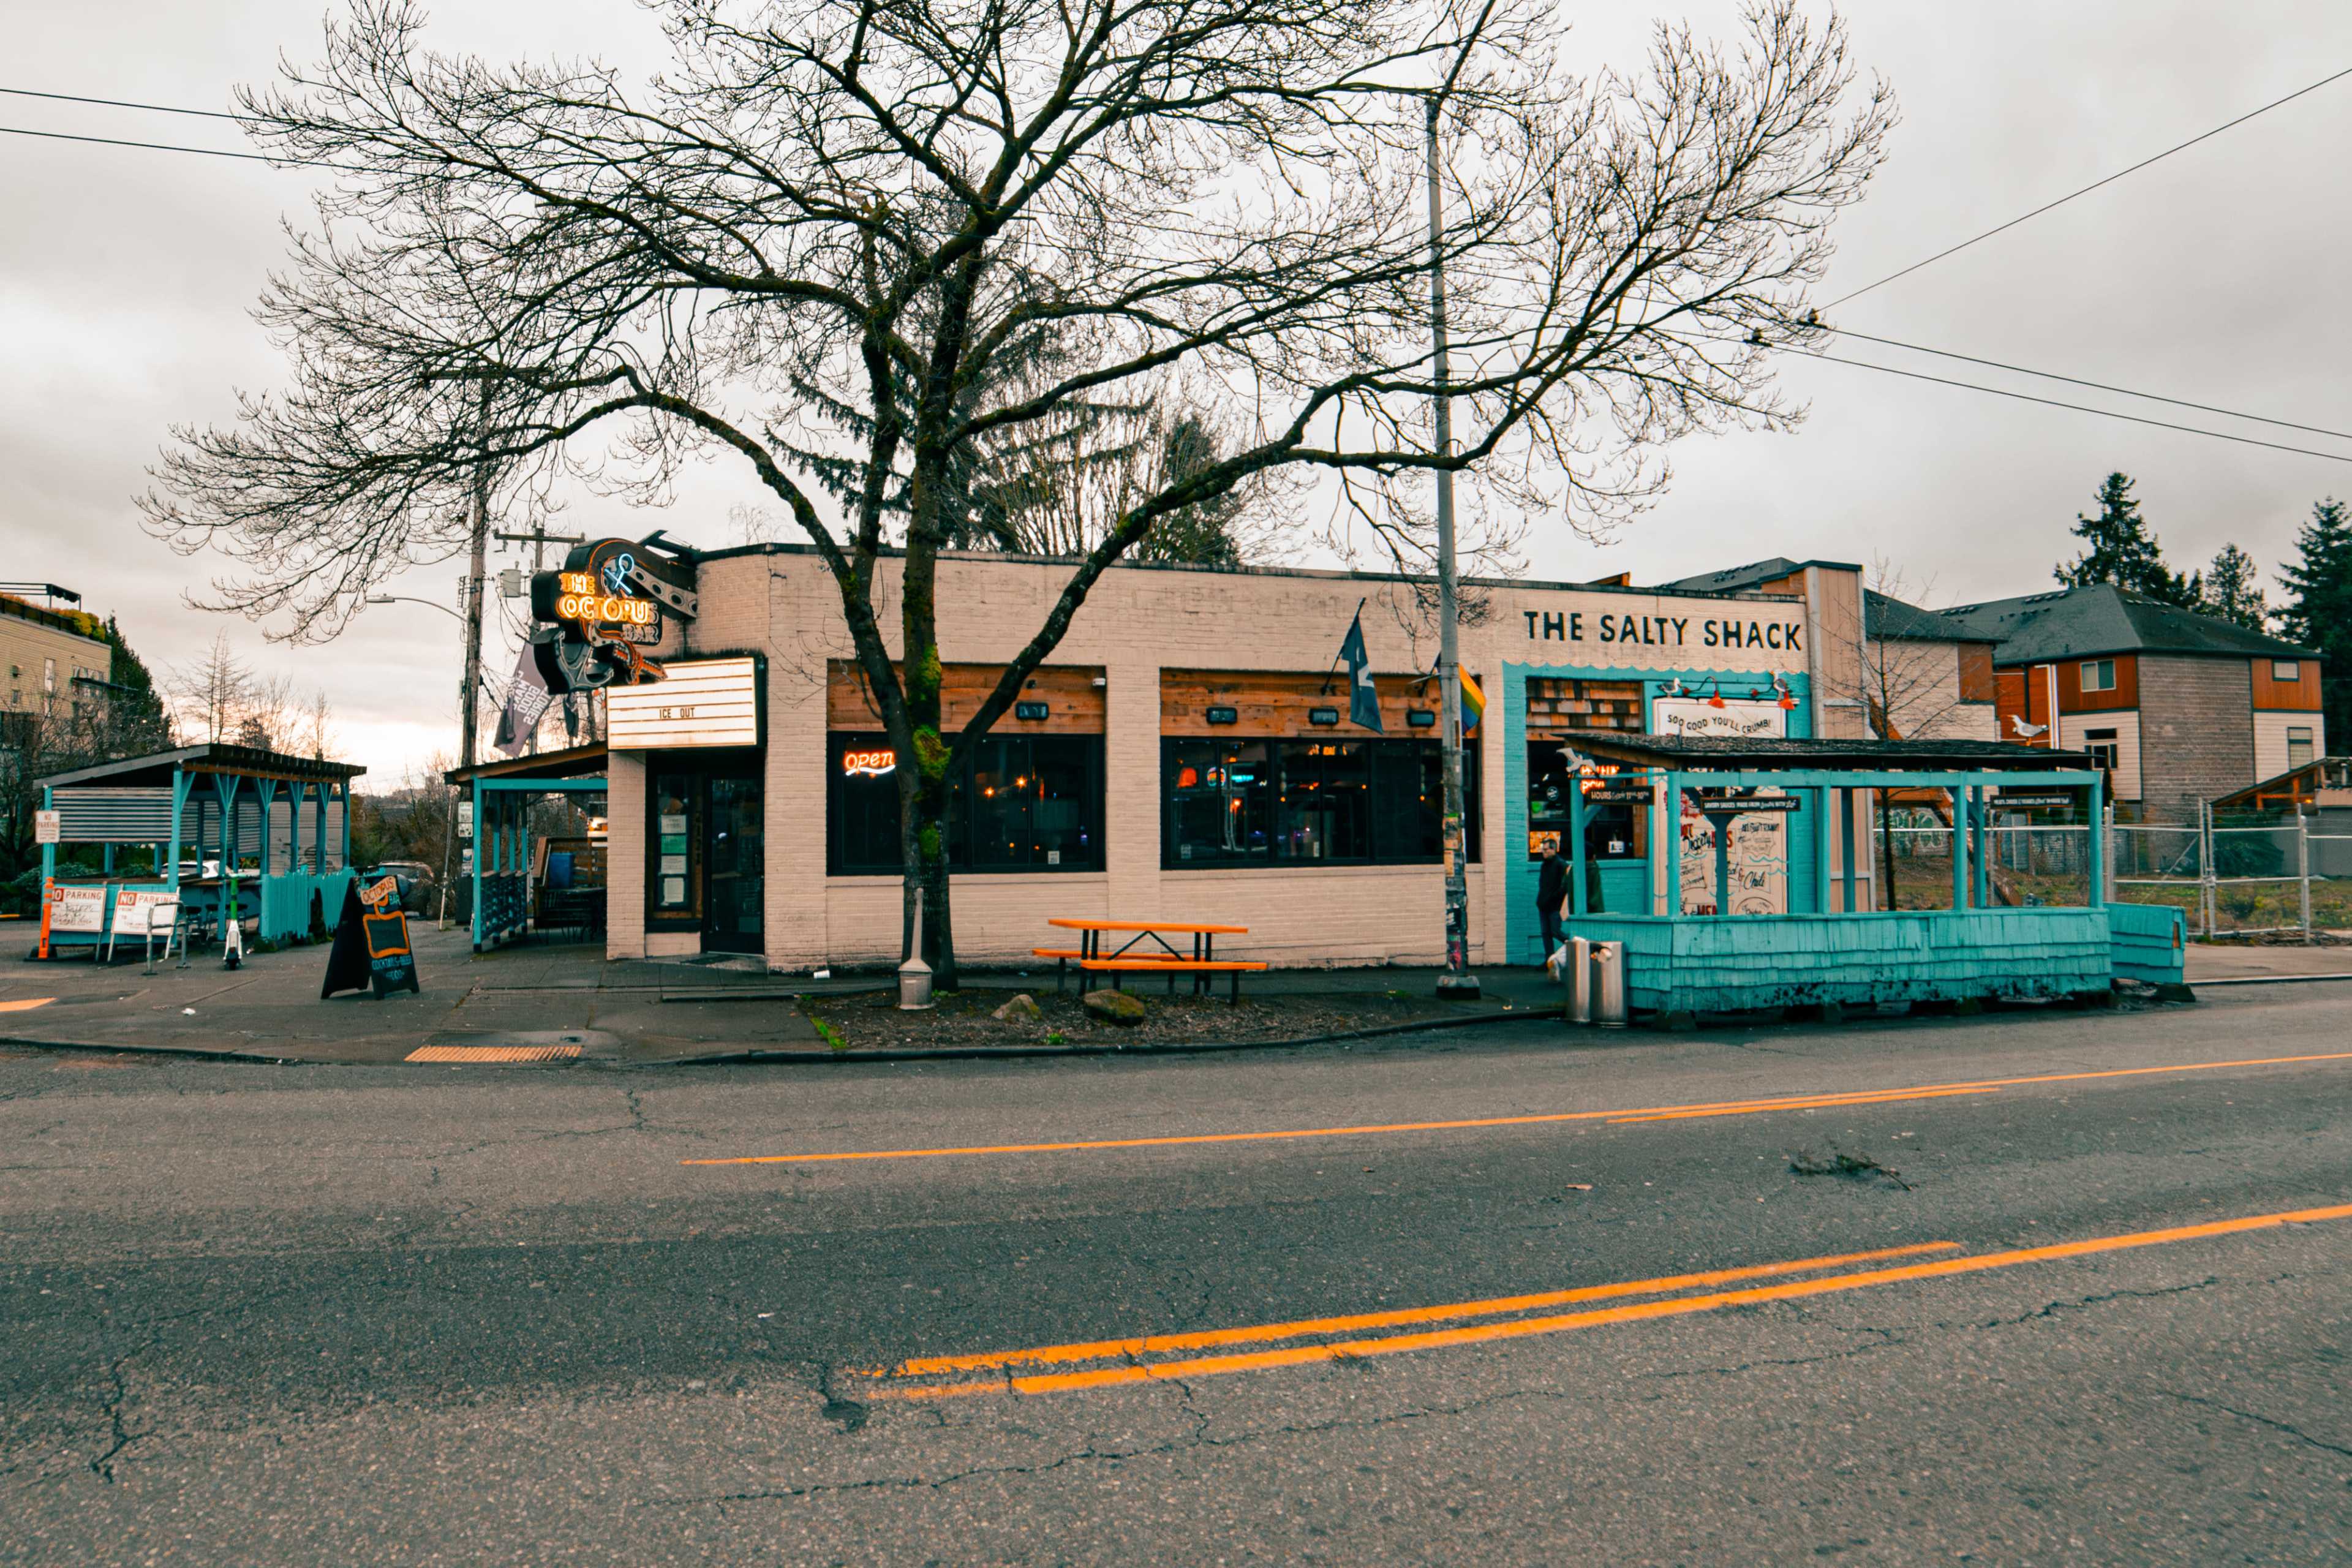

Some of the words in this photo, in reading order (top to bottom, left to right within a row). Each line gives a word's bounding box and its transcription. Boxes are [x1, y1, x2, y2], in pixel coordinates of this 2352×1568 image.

[559, 573, 595, 594] THE
[556, 595, 659, 624] OCTOPUS
[622, 624, 659, 643] BAR
[1524, 611, 1583, 641] THE
[1600, 614, 1688, 645] SALTY
[1704, 620, 1801, 650] SHACK
[659, 708, 671, 718] ICE
[680, 707, 695, 718] OUT
[1667, 714, 1684, 726] SOO
[1687, 719, 1708, 730] GOOD
[1711, 716, 1739, 731] YOU'LL
[1591, 791, 1611, 800] HOURS
[66, 891, 102, 901] PARKING
[121, 894, 134, 905] NO
[138, 895, 175, 903] PARKING
